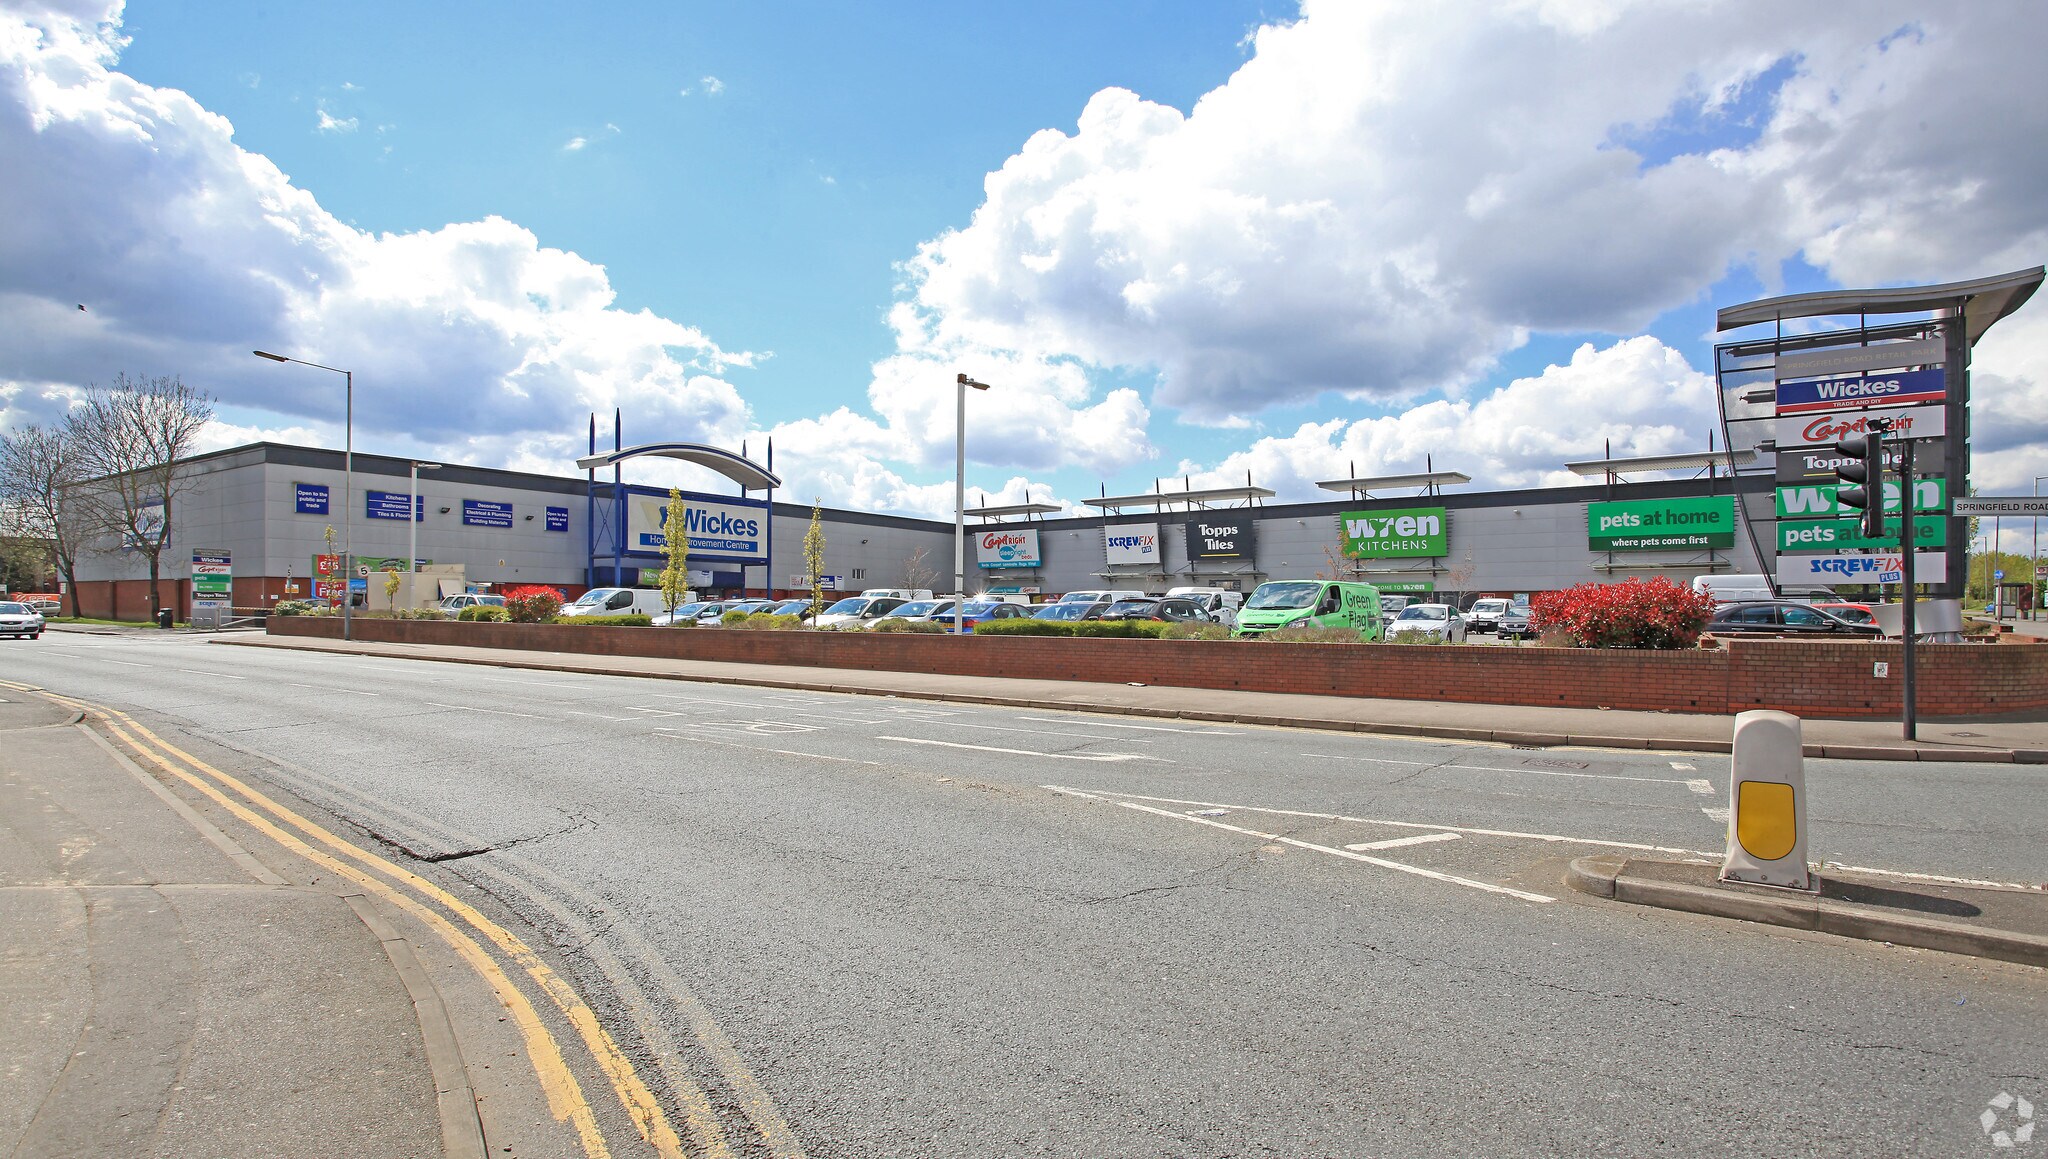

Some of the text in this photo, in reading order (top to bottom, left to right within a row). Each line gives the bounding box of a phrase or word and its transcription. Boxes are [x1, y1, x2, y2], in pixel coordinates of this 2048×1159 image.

[1784, 347, 1936, 370] SPRINGFIELD ROAD RETAIL PARK
[1817, 379, 1900, 399] Wickes
[1802, 415, 1913, 441] CarpetGHT
[386, 494, 408, 502] Kitchens
[477, 502, 501, 510] Decorating
[1956, 503, 2020, 511] SPRINGFIELD
[491, 511, 512, 519] Plumbing
[1600, 509, 1720, 531] pets at home
[683, 508, 758, 537] Wickes
[1345, 515, 1440, 539] wren
[1199, 524, 1239, 537] Topps
[1785, 526, 1835, 547] pets
[1839, 525, 1862, 541] at
[649, 535, 750, 550] Hom provement Centre
[1108, 536, 1154, 550] SCREWFIX
[1205, 538, 1234, 550] Tiles
[1358, 540, 1428, 551] KITCHENS
[1611, 535, 1709, 548] where pets come first
[361, 567, 368, 575] 5
[1811, 557, 1905, 578] SCREWFIX
[644, 571, 659, 579] New
[1880, 572, 1899, 582] PLUS
[1345, 590, 1371, 609] Green
[1348, 610, 1367, 632] Flag
